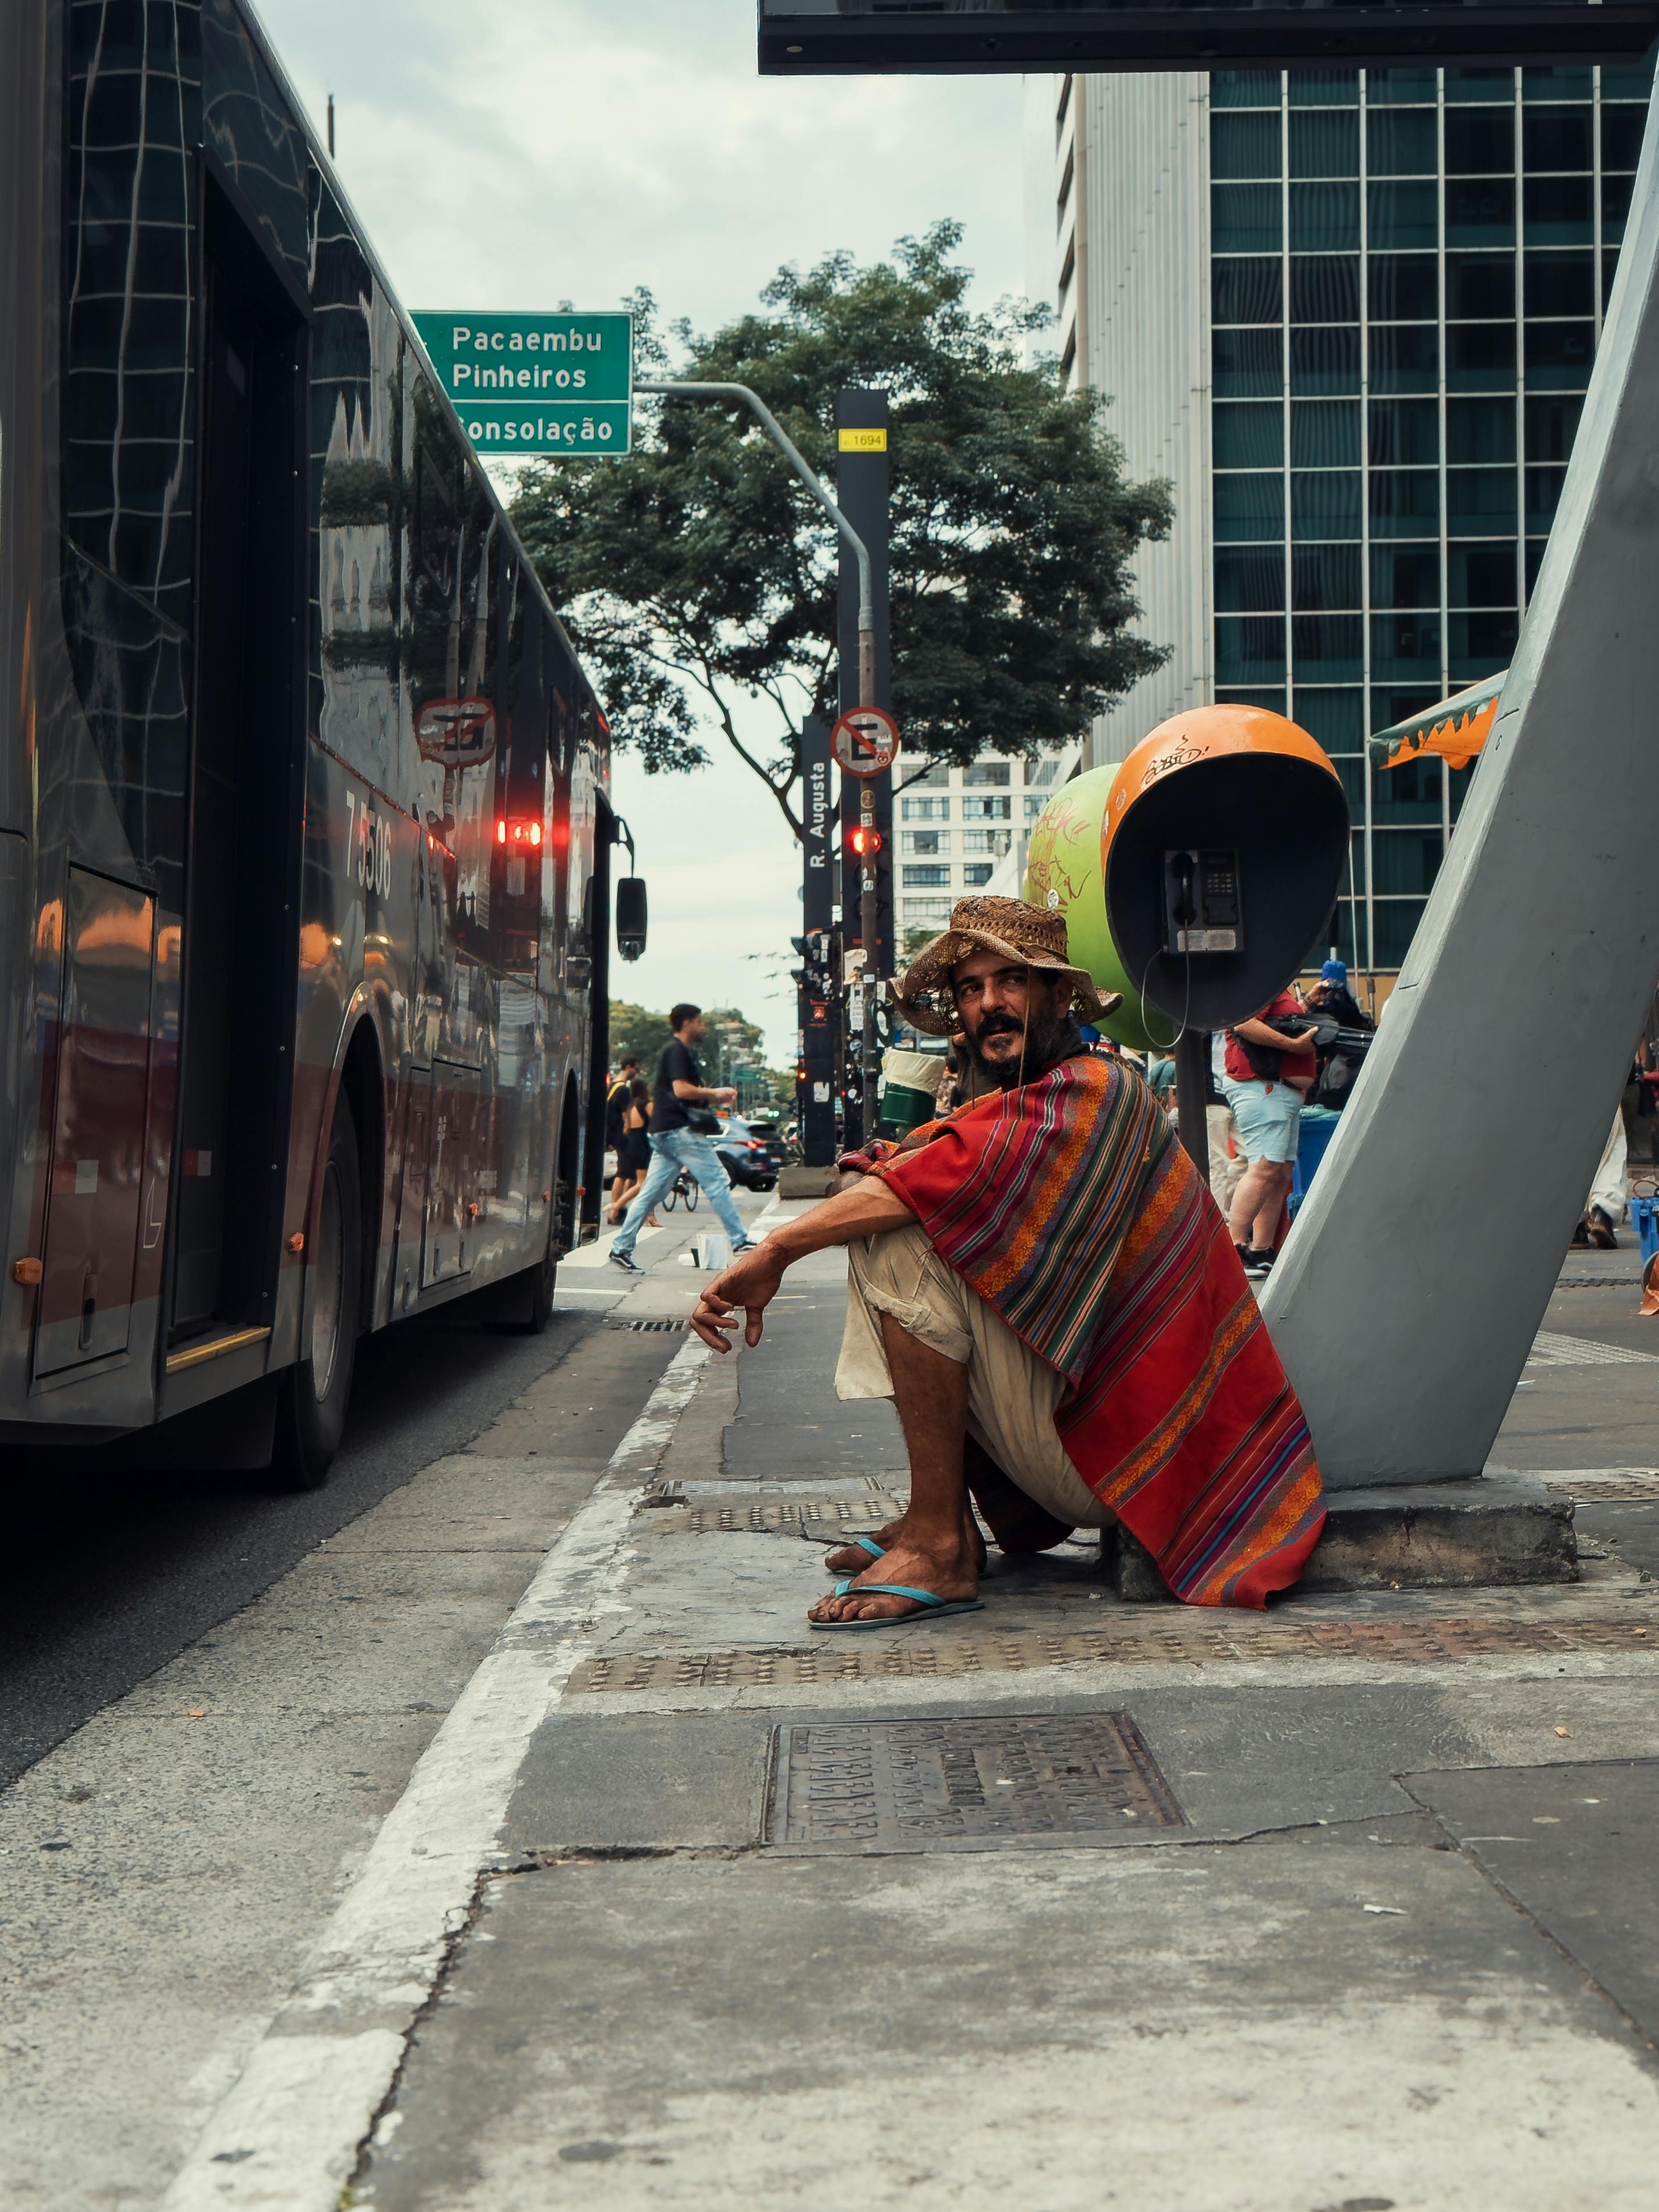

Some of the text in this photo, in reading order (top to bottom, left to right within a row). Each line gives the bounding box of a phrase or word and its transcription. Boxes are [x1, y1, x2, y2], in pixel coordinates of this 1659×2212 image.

[453, 327, 602, 352] Pacaembu
[453, 364, 586, 387] Pinheiros
[461, 416, 612, 446] onsolação
[854, 436, 881, 445] 1694
[810, 762, 828, 868] R. Augusta
